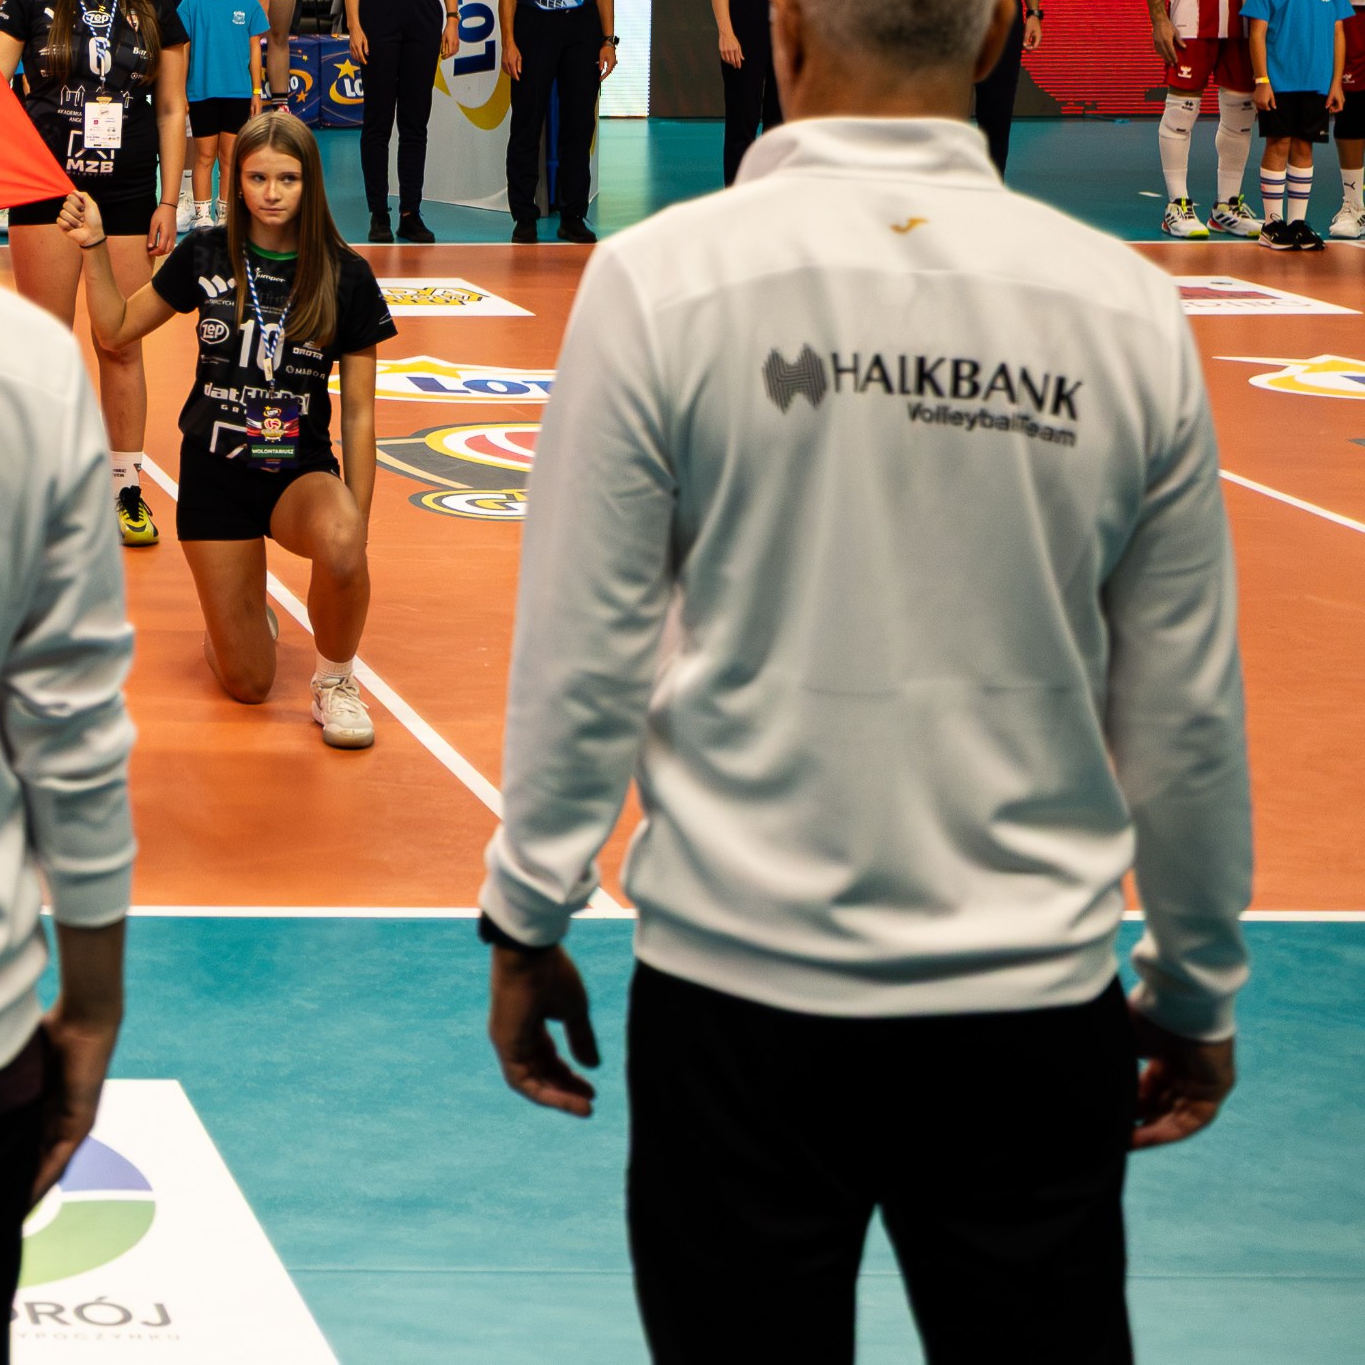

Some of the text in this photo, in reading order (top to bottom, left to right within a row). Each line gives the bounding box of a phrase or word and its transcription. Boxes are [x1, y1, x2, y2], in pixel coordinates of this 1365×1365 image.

[88, 36, 111, 76] 6
[66, 159, 114, 174] MZB
[239, 318, 284, 371] 10
[831, 352, 1084, 423] HALKBANK
[1019, 410, 1079, 447] Team
